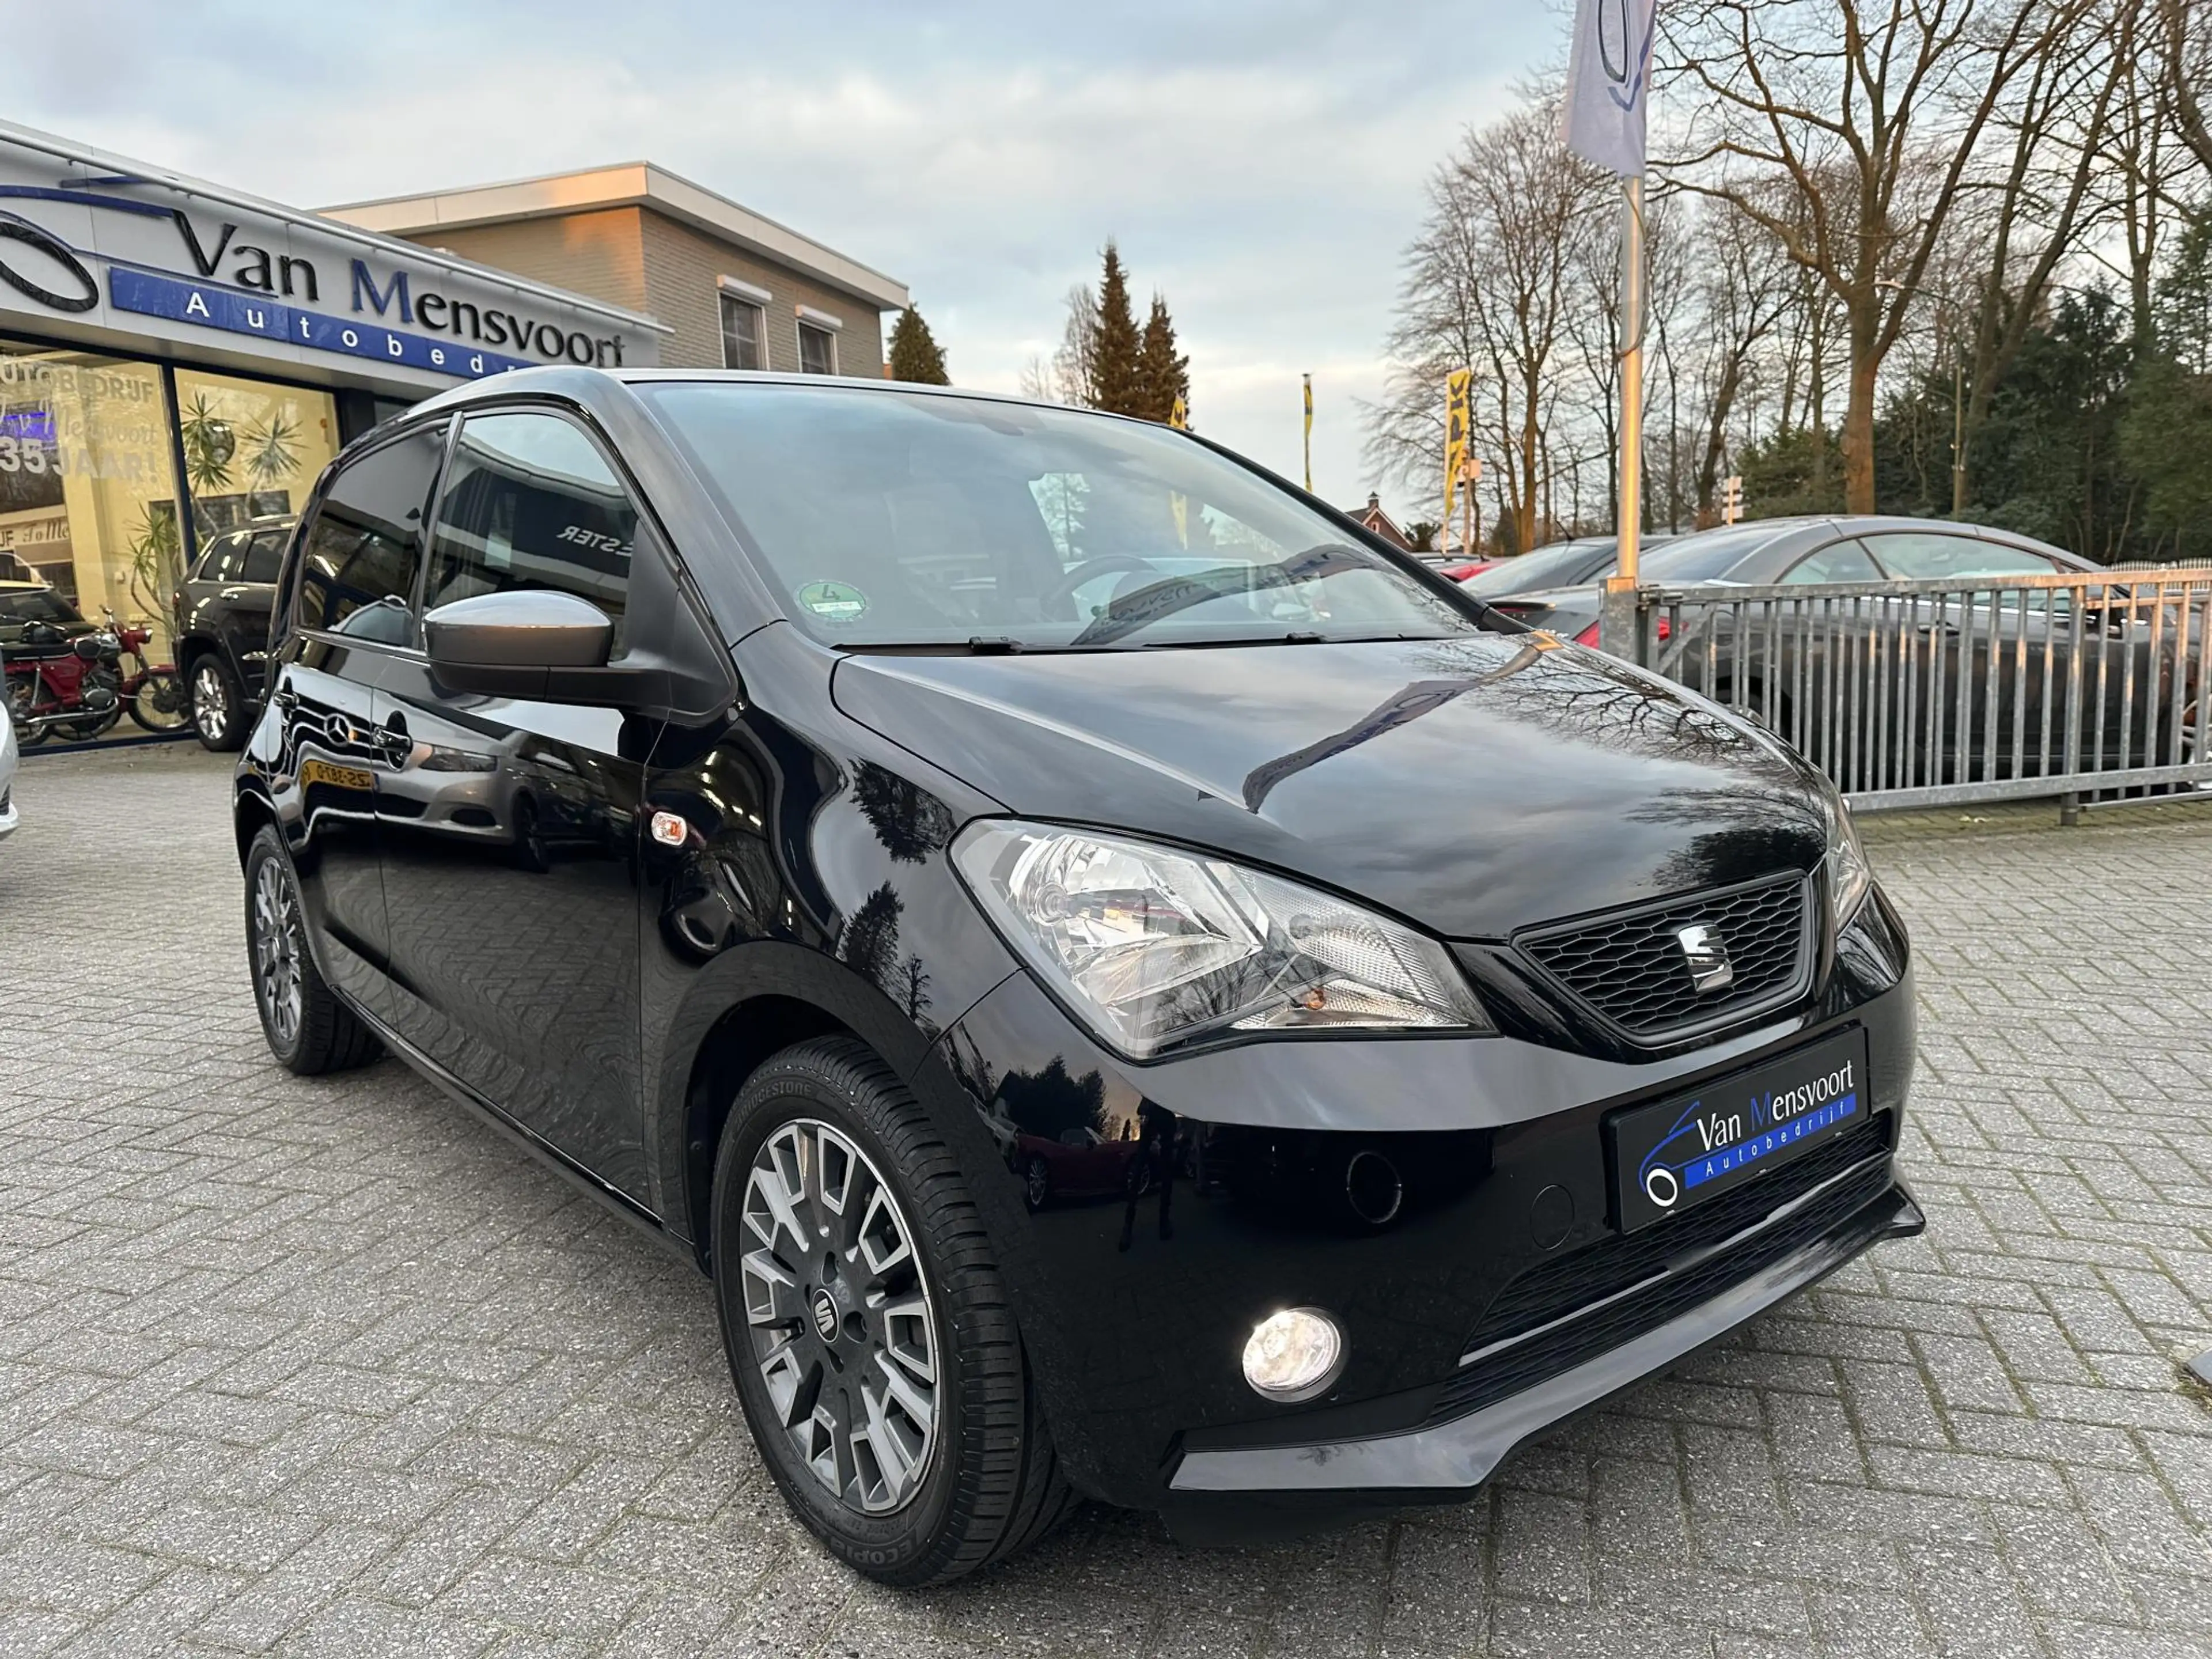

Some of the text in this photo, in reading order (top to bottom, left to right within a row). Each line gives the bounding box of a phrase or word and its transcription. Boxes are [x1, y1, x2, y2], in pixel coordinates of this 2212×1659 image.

[173, 210, 626, 367] Van Mensvoort
[1696, 1059, 1854, 1152] Van Mensvoort
[1705, 1101, 1844, 1177] Autobedrijf
